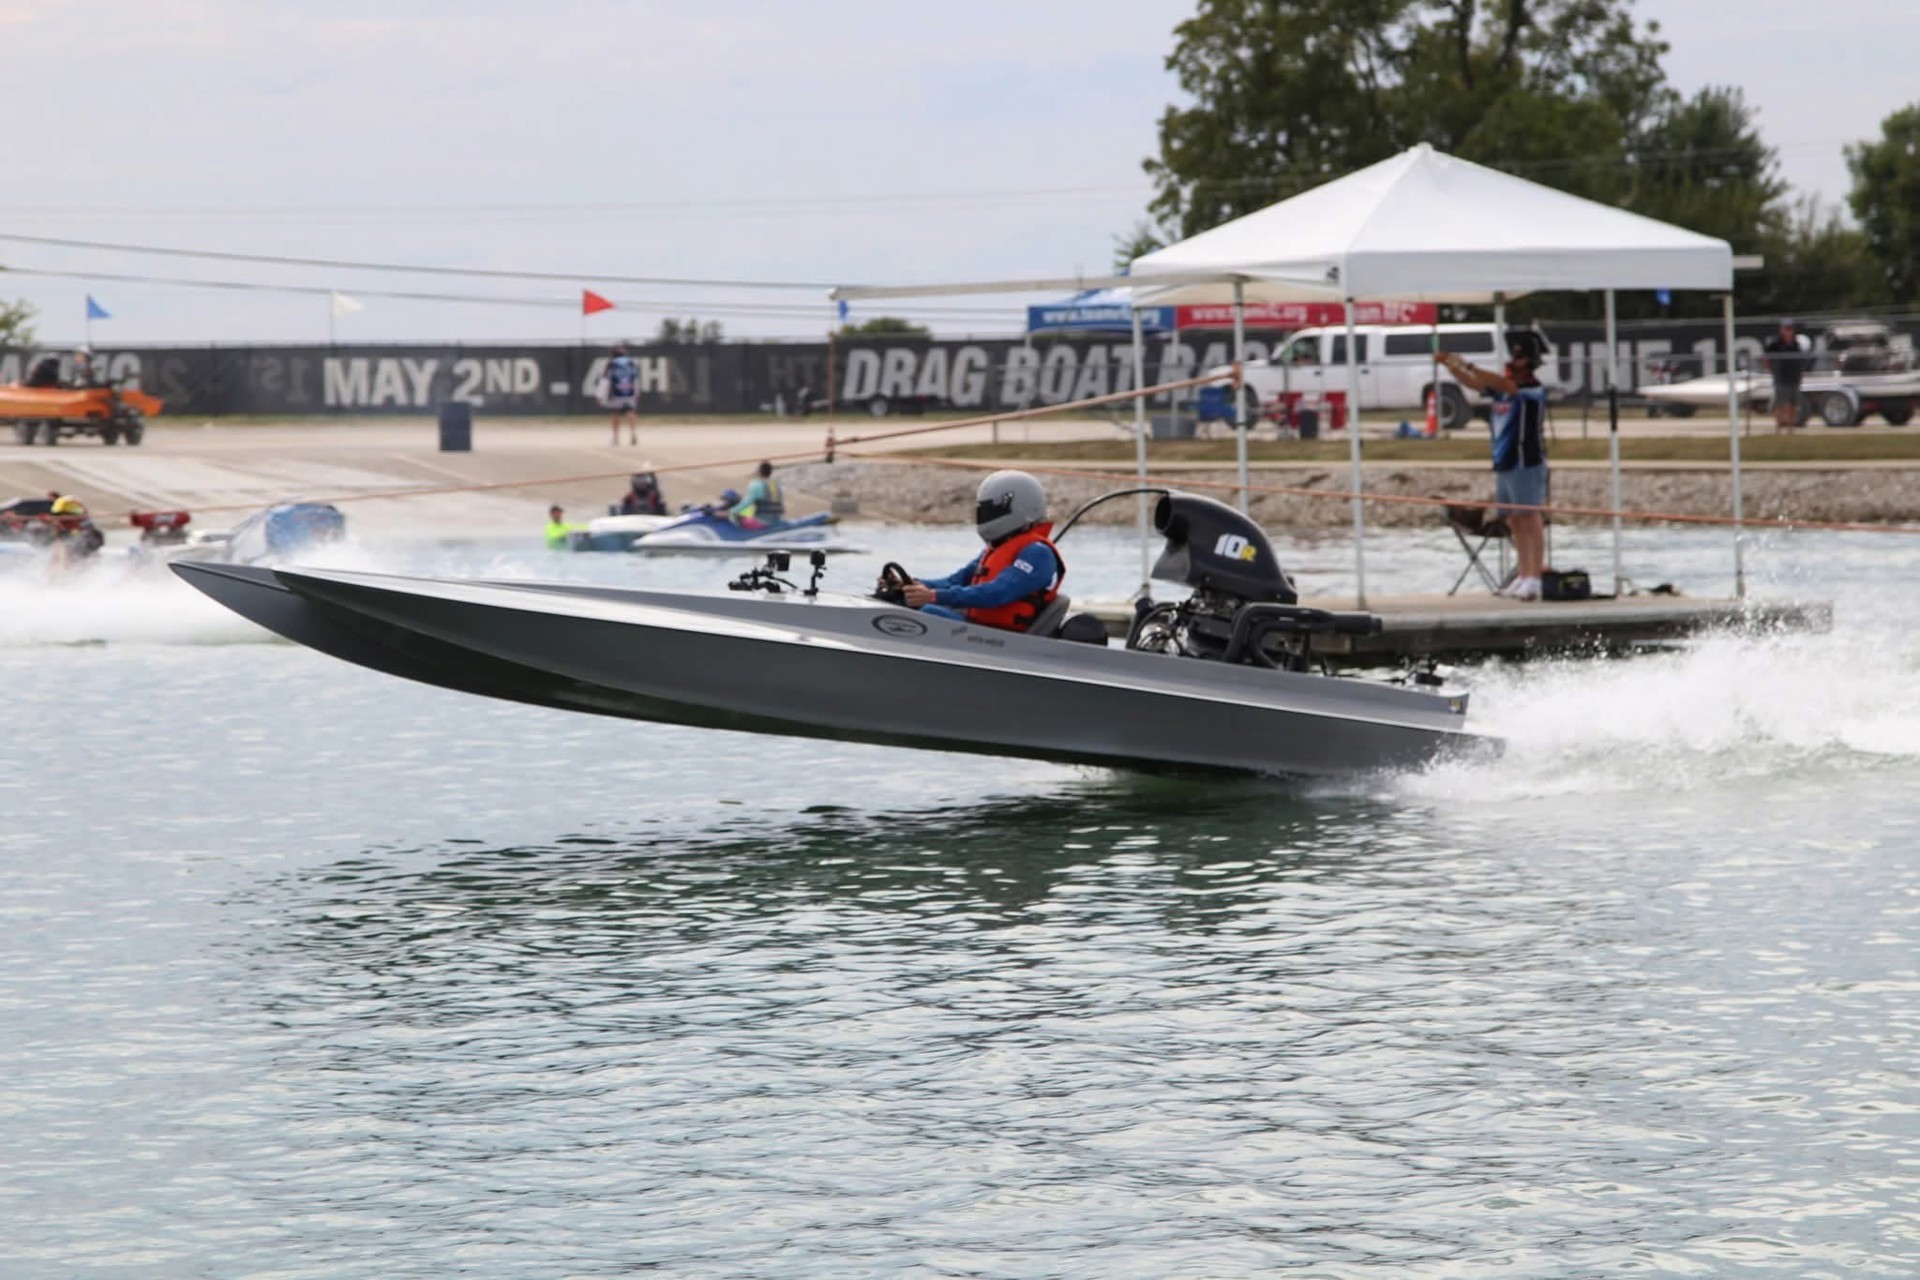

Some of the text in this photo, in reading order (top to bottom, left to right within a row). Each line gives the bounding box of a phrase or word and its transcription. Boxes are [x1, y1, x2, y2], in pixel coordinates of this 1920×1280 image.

[323, 357, 439, 406] MAY
[452, 357, 540, 406] 2ND
[582, 357, 669, 400] 4H
[842, 345, 988, 407] DRAG
[1001, 344, 1146, 405] BOAT
[1540, 338, 1672, 395] UNE
